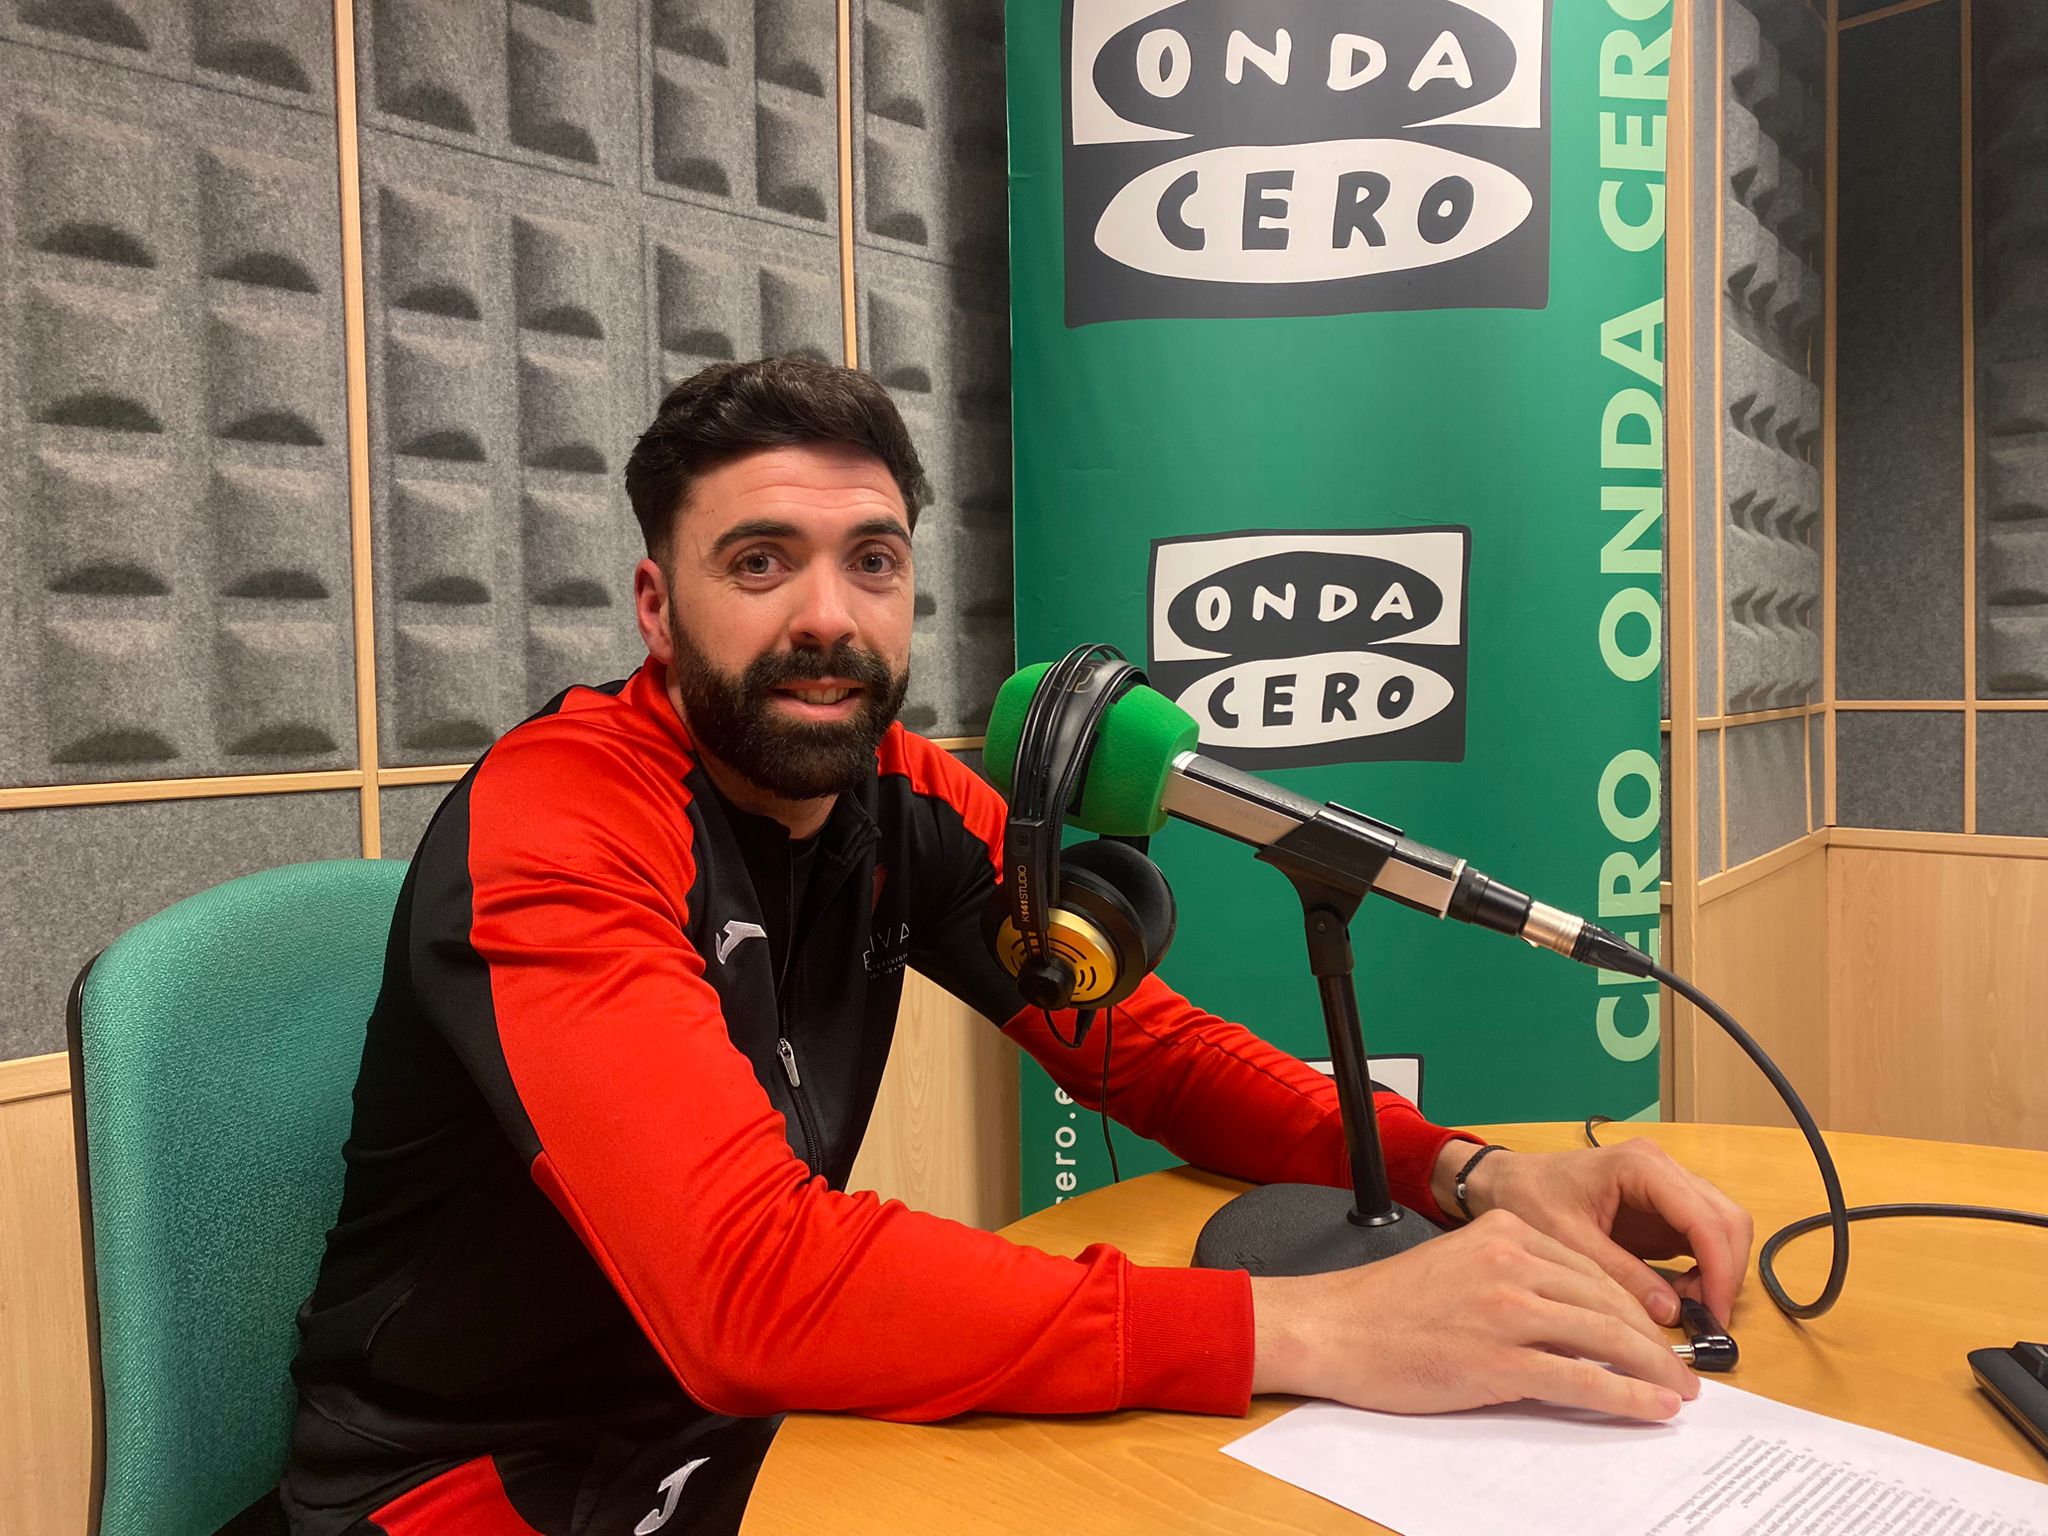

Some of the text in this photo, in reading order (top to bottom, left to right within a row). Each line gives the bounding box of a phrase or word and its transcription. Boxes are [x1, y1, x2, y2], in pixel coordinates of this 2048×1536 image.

[1136, 28, 1473, 98] ONDA
[1599, 0, 1672, 253] CER
[1156, 170, 1475, 252] CERO
[1599, 298, 1664, 682] ONDA
[1195, 582, 1415, 632] ONDA
[1207, 671, 1416, 730] CERO
